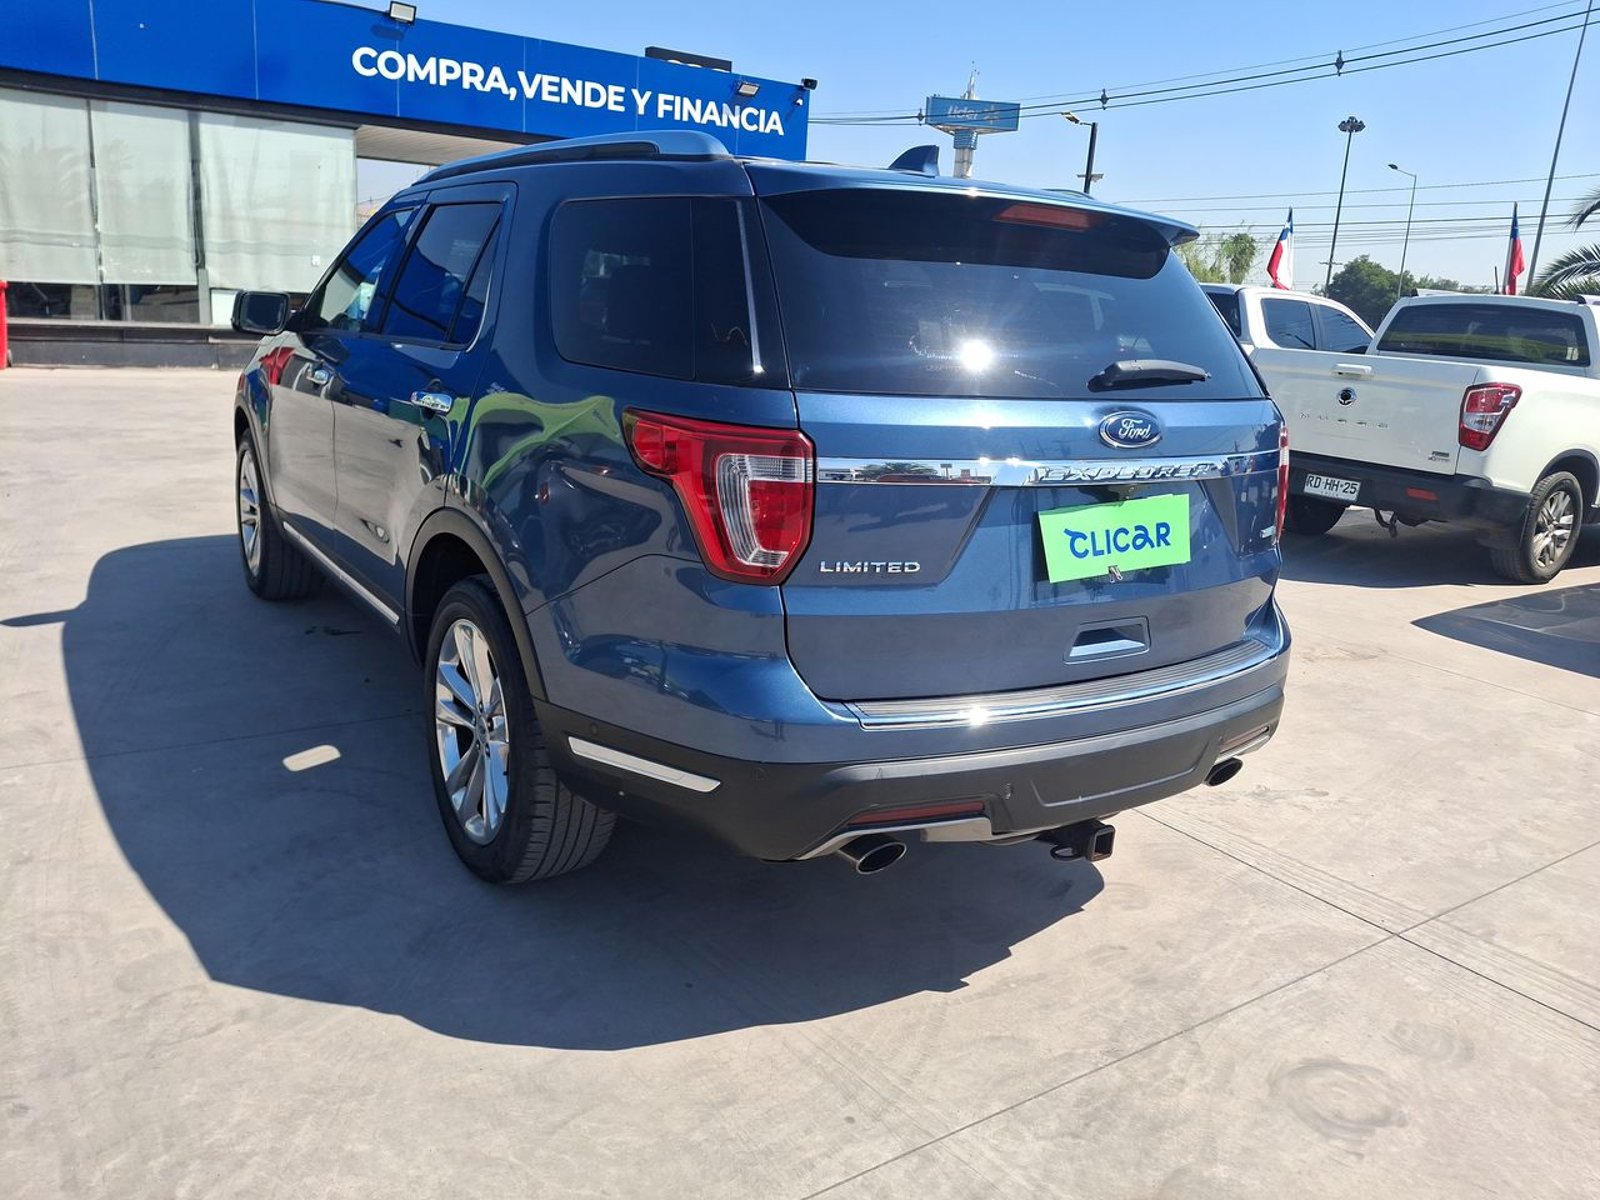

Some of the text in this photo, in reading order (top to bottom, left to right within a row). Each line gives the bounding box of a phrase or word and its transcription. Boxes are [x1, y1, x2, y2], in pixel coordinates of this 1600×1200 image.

[517, 70, 626, 112] VENDE
[631, 88, 652, 115] Y
[657, 93, 785, 136] FINANCIA
[1118, 418, 1151, 438] Ford
[1041, 463, 1214, 482] EXPLORER
[820, 560, 921, 573] LIMITED
